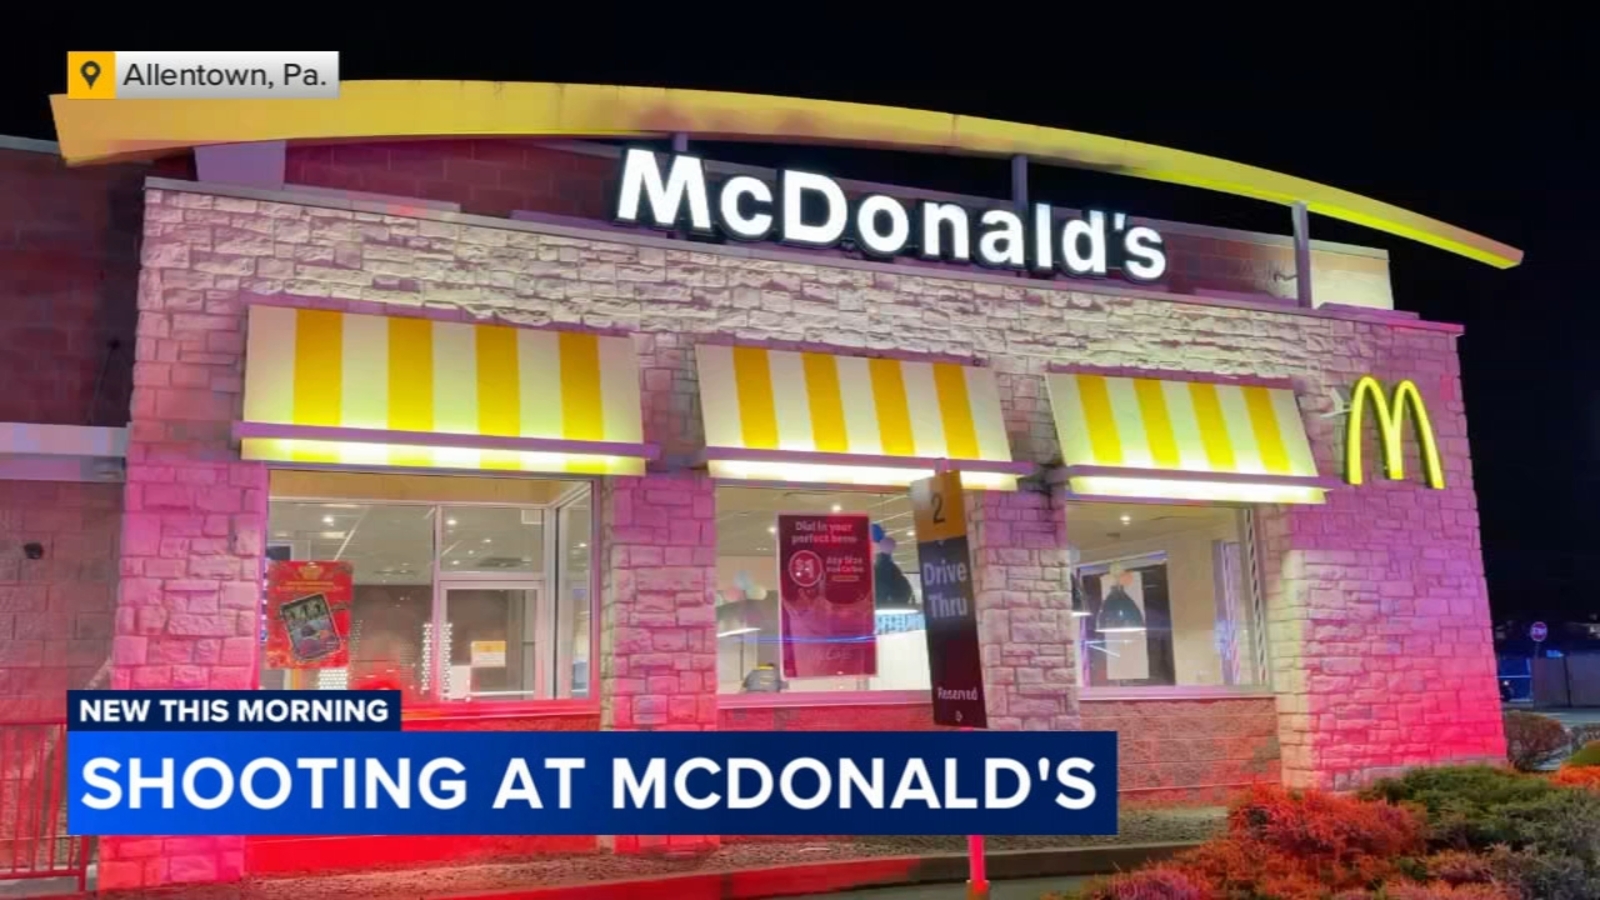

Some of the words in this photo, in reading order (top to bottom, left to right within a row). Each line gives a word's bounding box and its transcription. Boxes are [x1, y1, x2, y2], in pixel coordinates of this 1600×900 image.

[614, 146, 1169, 281] McDonald's
[931, 492, 946, 524] 2
[791, 534, 829, 546] perfect
[829, 523, 853, 536] your
[923, 559, 968, 586] Drive
[928, 593, 968, 618] Thru
[937, 686, 978, 701] Reserved
